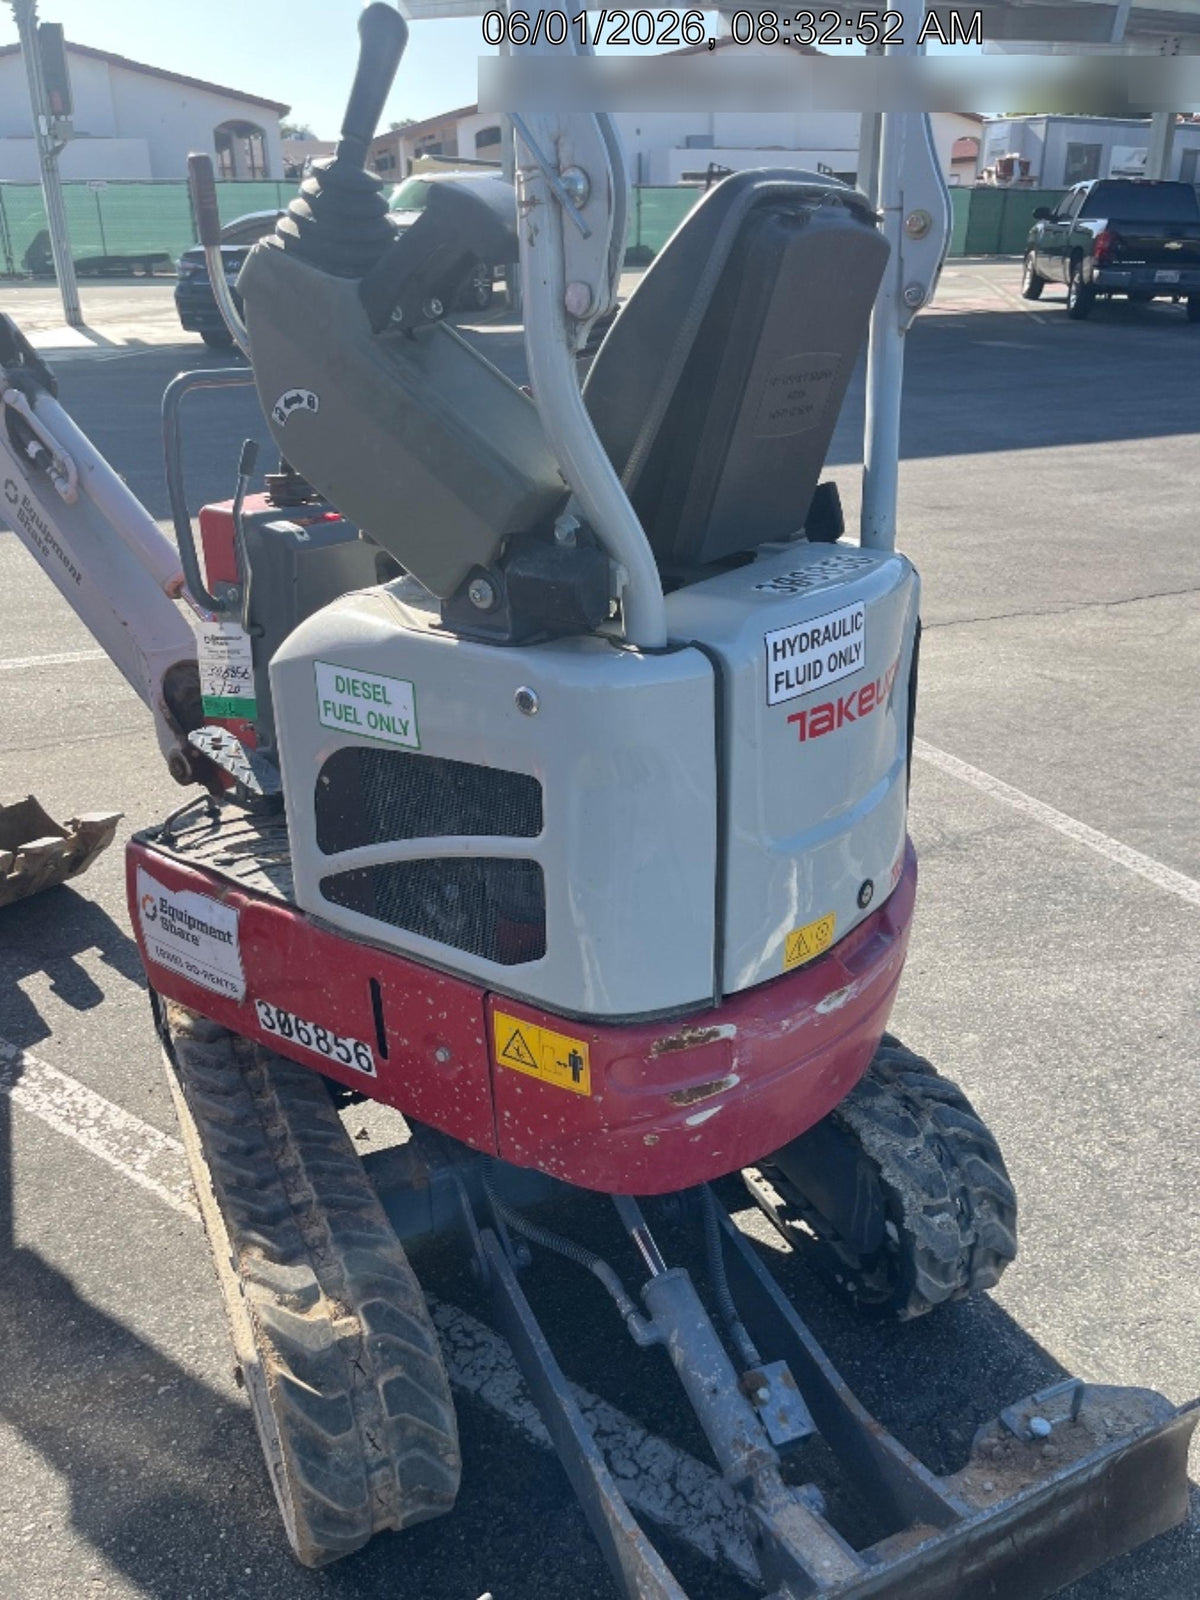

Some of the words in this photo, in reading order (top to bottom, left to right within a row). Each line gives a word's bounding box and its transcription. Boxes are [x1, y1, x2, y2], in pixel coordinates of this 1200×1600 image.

[21, 494, 82, 586] Equipment
[772, 611, 863, 662] HYDRAULIC
[335, 675, 391, 705] DIESEL
[774, 660, 823, 694] FLUID
[828, 640, 863, 673] ONLY
[323, 700, 362, 725] FUEL
[367, 711, 410, 736] ONLY
[159, 897, 233, 946] Equipment
[160, 916, 200, 946] Share
[257, 1000, 372, 1072] 306856
